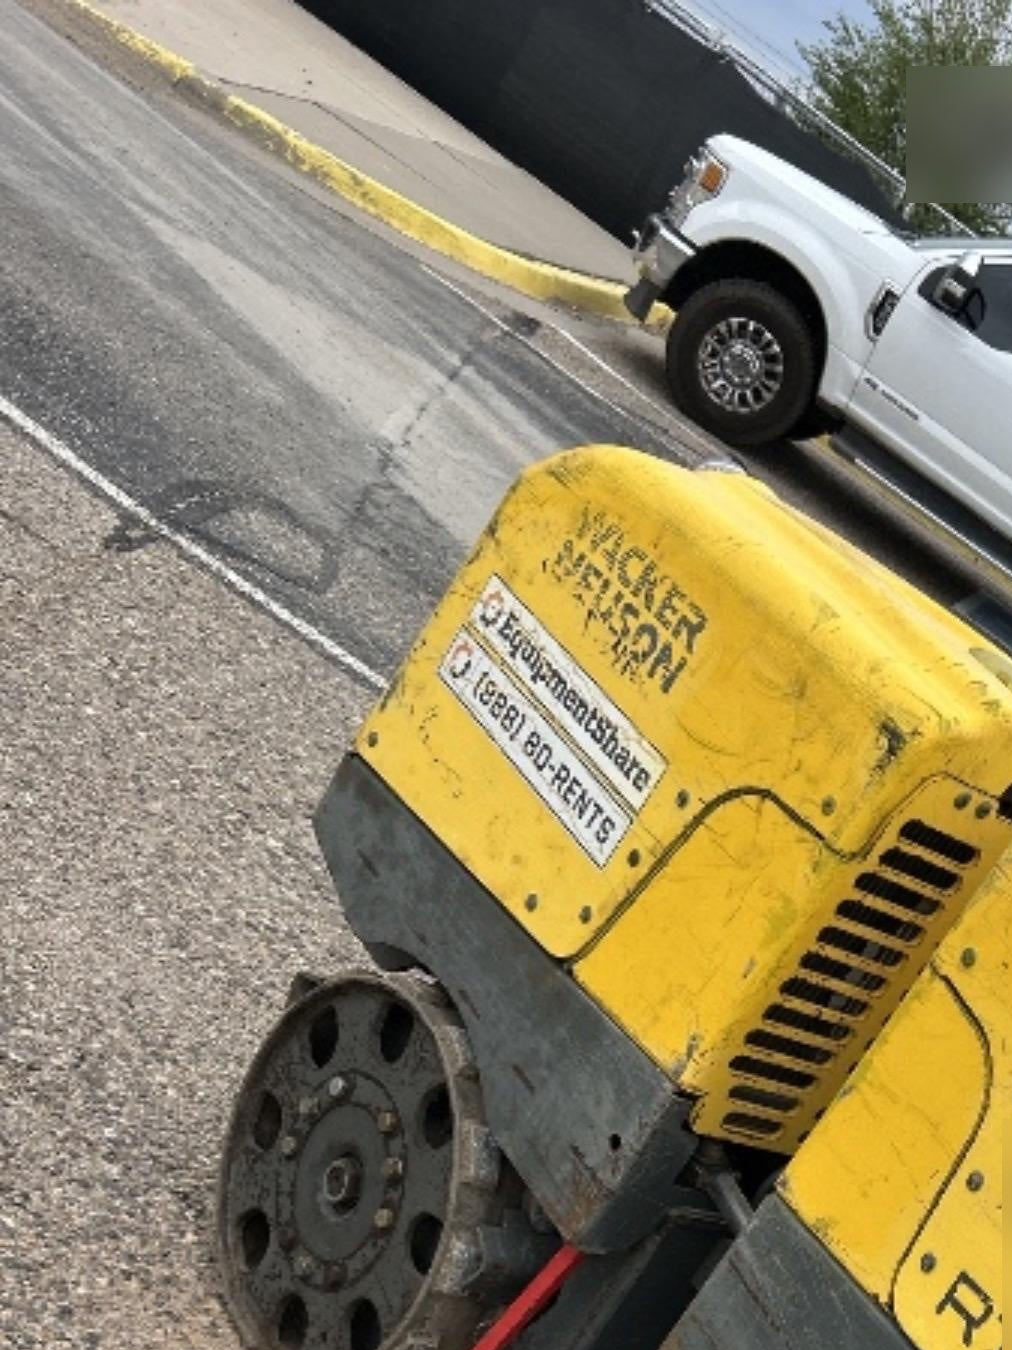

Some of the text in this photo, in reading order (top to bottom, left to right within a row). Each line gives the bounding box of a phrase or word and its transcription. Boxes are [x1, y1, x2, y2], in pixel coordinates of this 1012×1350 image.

[576, 505, 708, 655] WACKER
[473, 670, 527, 739] (888)
[499, 610, 654, 793] EquipmentShare
